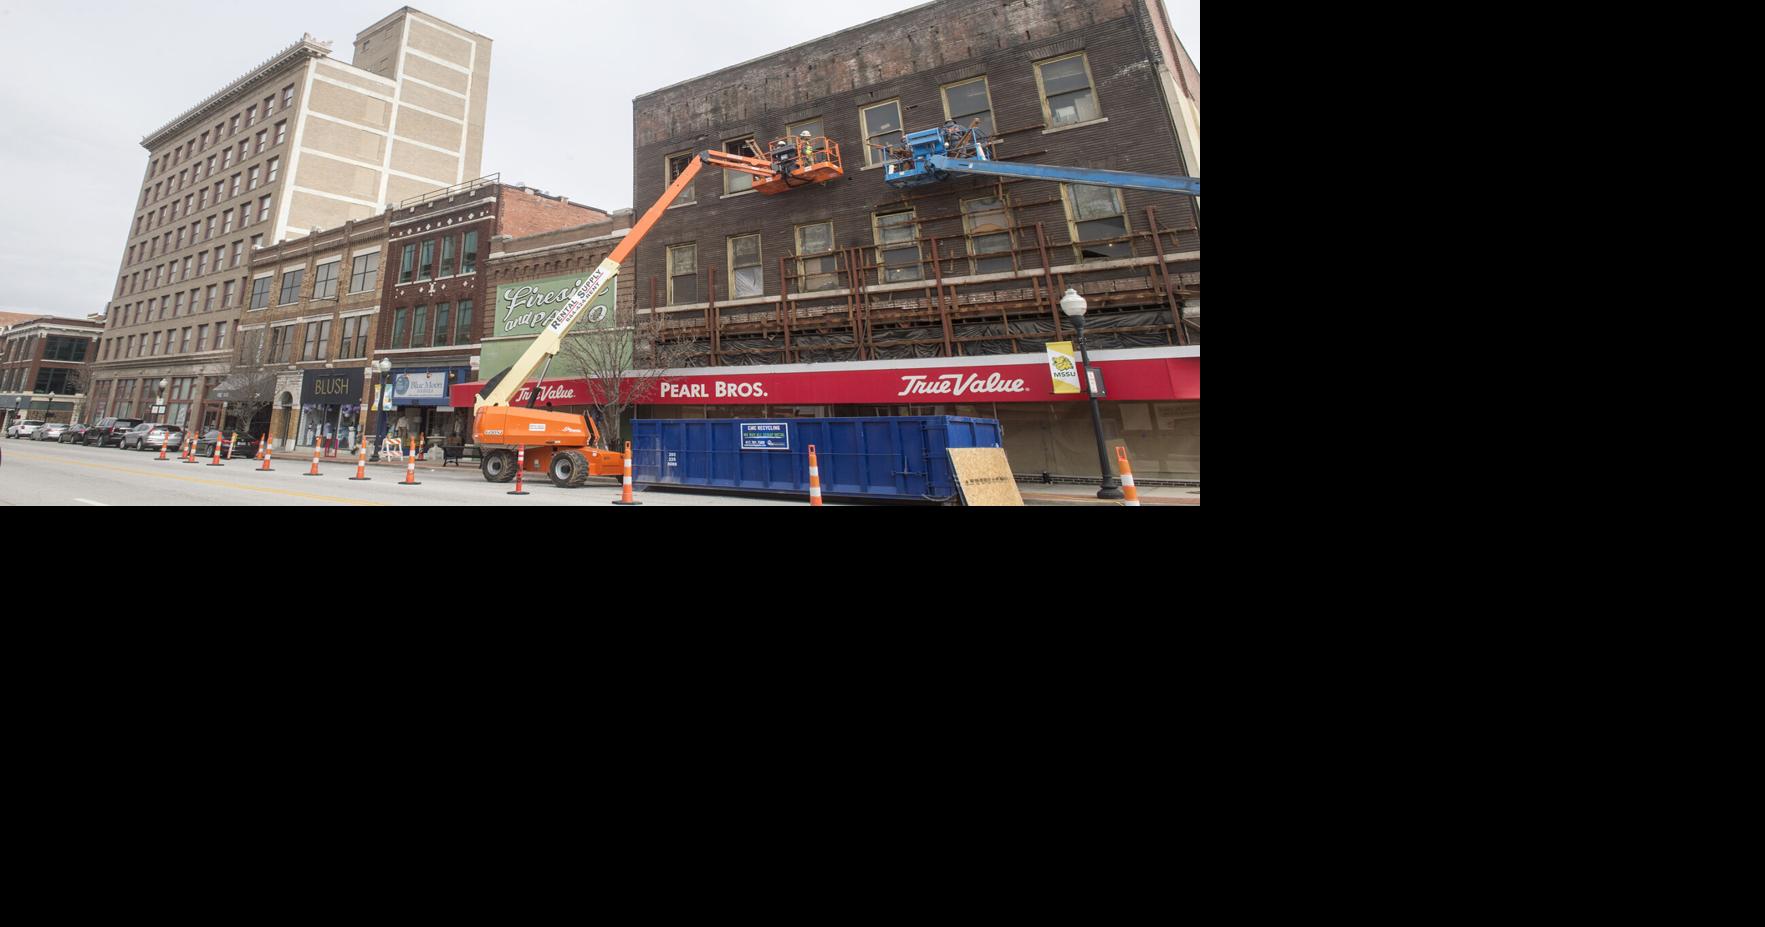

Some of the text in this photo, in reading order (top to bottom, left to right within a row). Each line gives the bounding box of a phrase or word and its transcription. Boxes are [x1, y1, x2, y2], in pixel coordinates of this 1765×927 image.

[504, 279, 609, 322] Firesi
[551, 269, 603, 330] RENTAL SUPPLY
[504, 304, 607, 332] and PAO
[315, 378, 349, 395] BLUSH
[660, 381, 768, 398] PEARL BROS.
